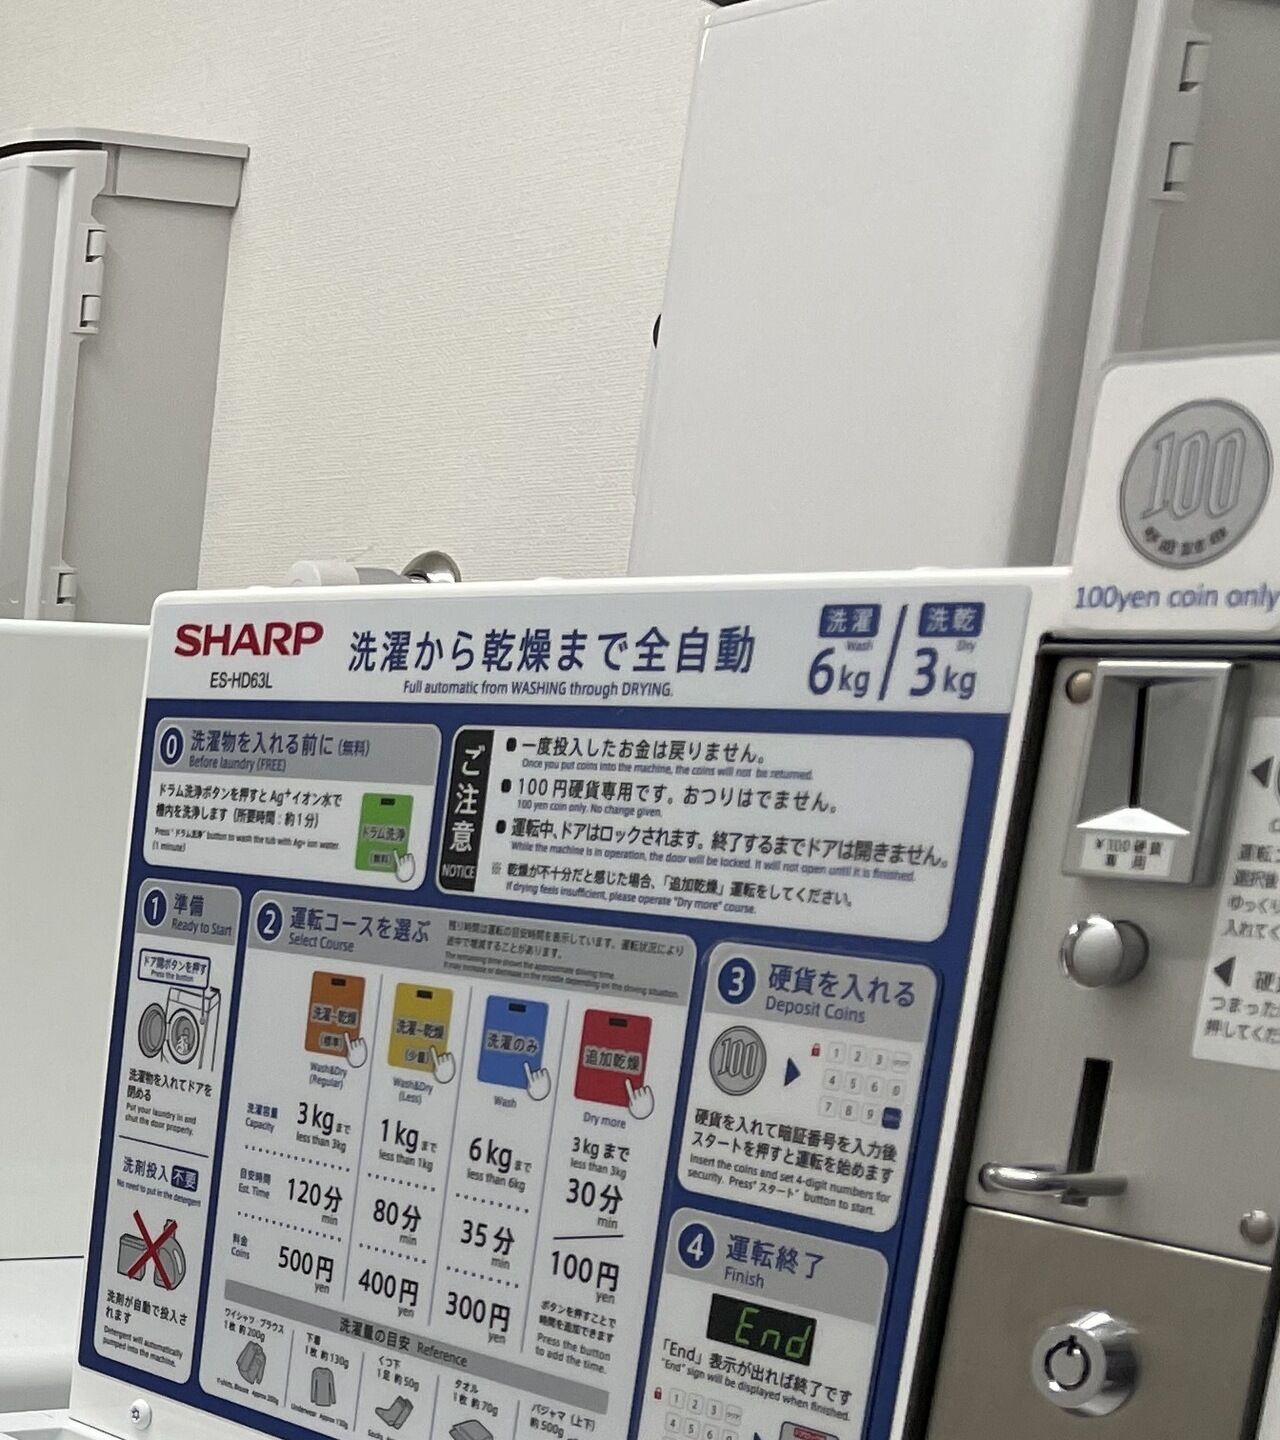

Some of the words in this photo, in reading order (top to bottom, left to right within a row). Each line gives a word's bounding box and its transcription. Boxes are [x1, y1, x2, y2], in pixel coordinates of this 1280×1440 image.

[1142, 428, 1246, 519] 100
[1076, 584, 1160, 612] 100yen
[1168, 583, 1217, 606] coin
[1226, 581, 1279, 612] only
[826, 607, 875, 633] 洗濯
[926, 606, 976, 633] 洗乾
[174, 621, 324, 657] SHARP
[348, 625, 755, 673] 洗濯から乾燥まで全自動
[846, 639, 873, 651] Wash
[956, 639, 975, 654] Dry
[210, 672, 272, 689] ES-HD63L
[404, 680, 421, 693] Full
[424, 681, 478, 695] automatic
[482, 681, 508, 694] from
[512, 682, 566, 697] WASHING
[569, 682, 618, 699] through
[622, 682, 673, 698] DRYING.
[191, 730, 333, 757] 洗濯物を入れる前に
[337, 739, 370, 757] (無料)
[522, 736, 764, 765] 一度投入したお金は戻りません。
[189, 755, 218, 770] Before
[219, 757, 255, 773] laundry
[256, 758, 287, 773] (FREE)
[450, 744, 486, 852] ご注意
[517, 799, 532, 810] 100
[533, 801, 548, 812] yen
[549, 801, 566, 811] coin
[568, 802, 589, 814] only.
[590, 803, 603, 814] No
[604, 805, 635, 817] change
[637, 806, 662, 819] given.
[361, 825, 406, 842] ドラム洗浄
[441, 863, 477, 880] NOTICE
[173, 893, 204, 917] 準備
[171, 918, 199, 933] Ready
[200, 921, 210, 933] to
[212, 923, 232, 936] Start
[290, 906, 429, 943] 運転コースを選ぶ
[289, 932, 316, 950] Select
[319, 935, 355, 953] Course
[768, 964, 915, 1008] 硬貨を入れる
[765, 996, 820, 1017] Deposit
[824, 1004, 866, 1023] Coins
[487, 1031, 539, 1056] 洗濯のみ
[310, 1062, 347, 1078] Wash&Dry
[585, 1047, 640, 1074] 追加乾燥
[129, 1068, 212, 1097] 洗濯物を入れてドアを
[393, 1077, 433, 1096] Wash&Dry
[246, 1102, 278, 1120] 洗濯容量
[494, 1096, 517, 1110] Wash
[245, 1117, 275, 1134] Capacity
[583, 1111, 601, 1128] Dry
[602, 1115, 627, 1130] more
[695, 1108, 898, 1162] 硬貨を入れて暗証番号を入力後
[692, 1131, 894, 1183] スタートを押すと運転を始めます
[123, 1156, 168, 1183] 洗剤投入
[172, 1167, 197, 1190] 不要
[288, 1177, 343, 1214] 120分
[566, 1178, 624, 1215] 30分
[373, 1199, 422, 1233] 80分
[460, 1219, 515, 1256] 35分
[278, 1246, 335, 1284] 500円
[726, 1233, 824, 1279] 運転終了
[551, 1249, 620, 1293] 100円
[724, 1265, 765, 1289] Finish
[358, 1268, 420, 1308] 400円
[105, 1306, 132, 1324] れます
[107, 1289, 188, 1326] 洗剤が自動で投入さ
[445, 1291, 511, 1333] 300円
[541, 1300, 617, 1329] ボタンを押すことで
[339, 1316, 411, 1352] 洗濯量の目安
[539, 1314, 615, 1344] 時間を追加できます
[735, 1306, 813, 1361] End
[378, 1355, 401, 1370] くつ下
[416, 1341, 469, 1369] Reference
[454, 1378, 479, 1395] タオル
[530, 1403, 568, 1422] パジャマ
[569, 1411, 596, 1433] (上下)
